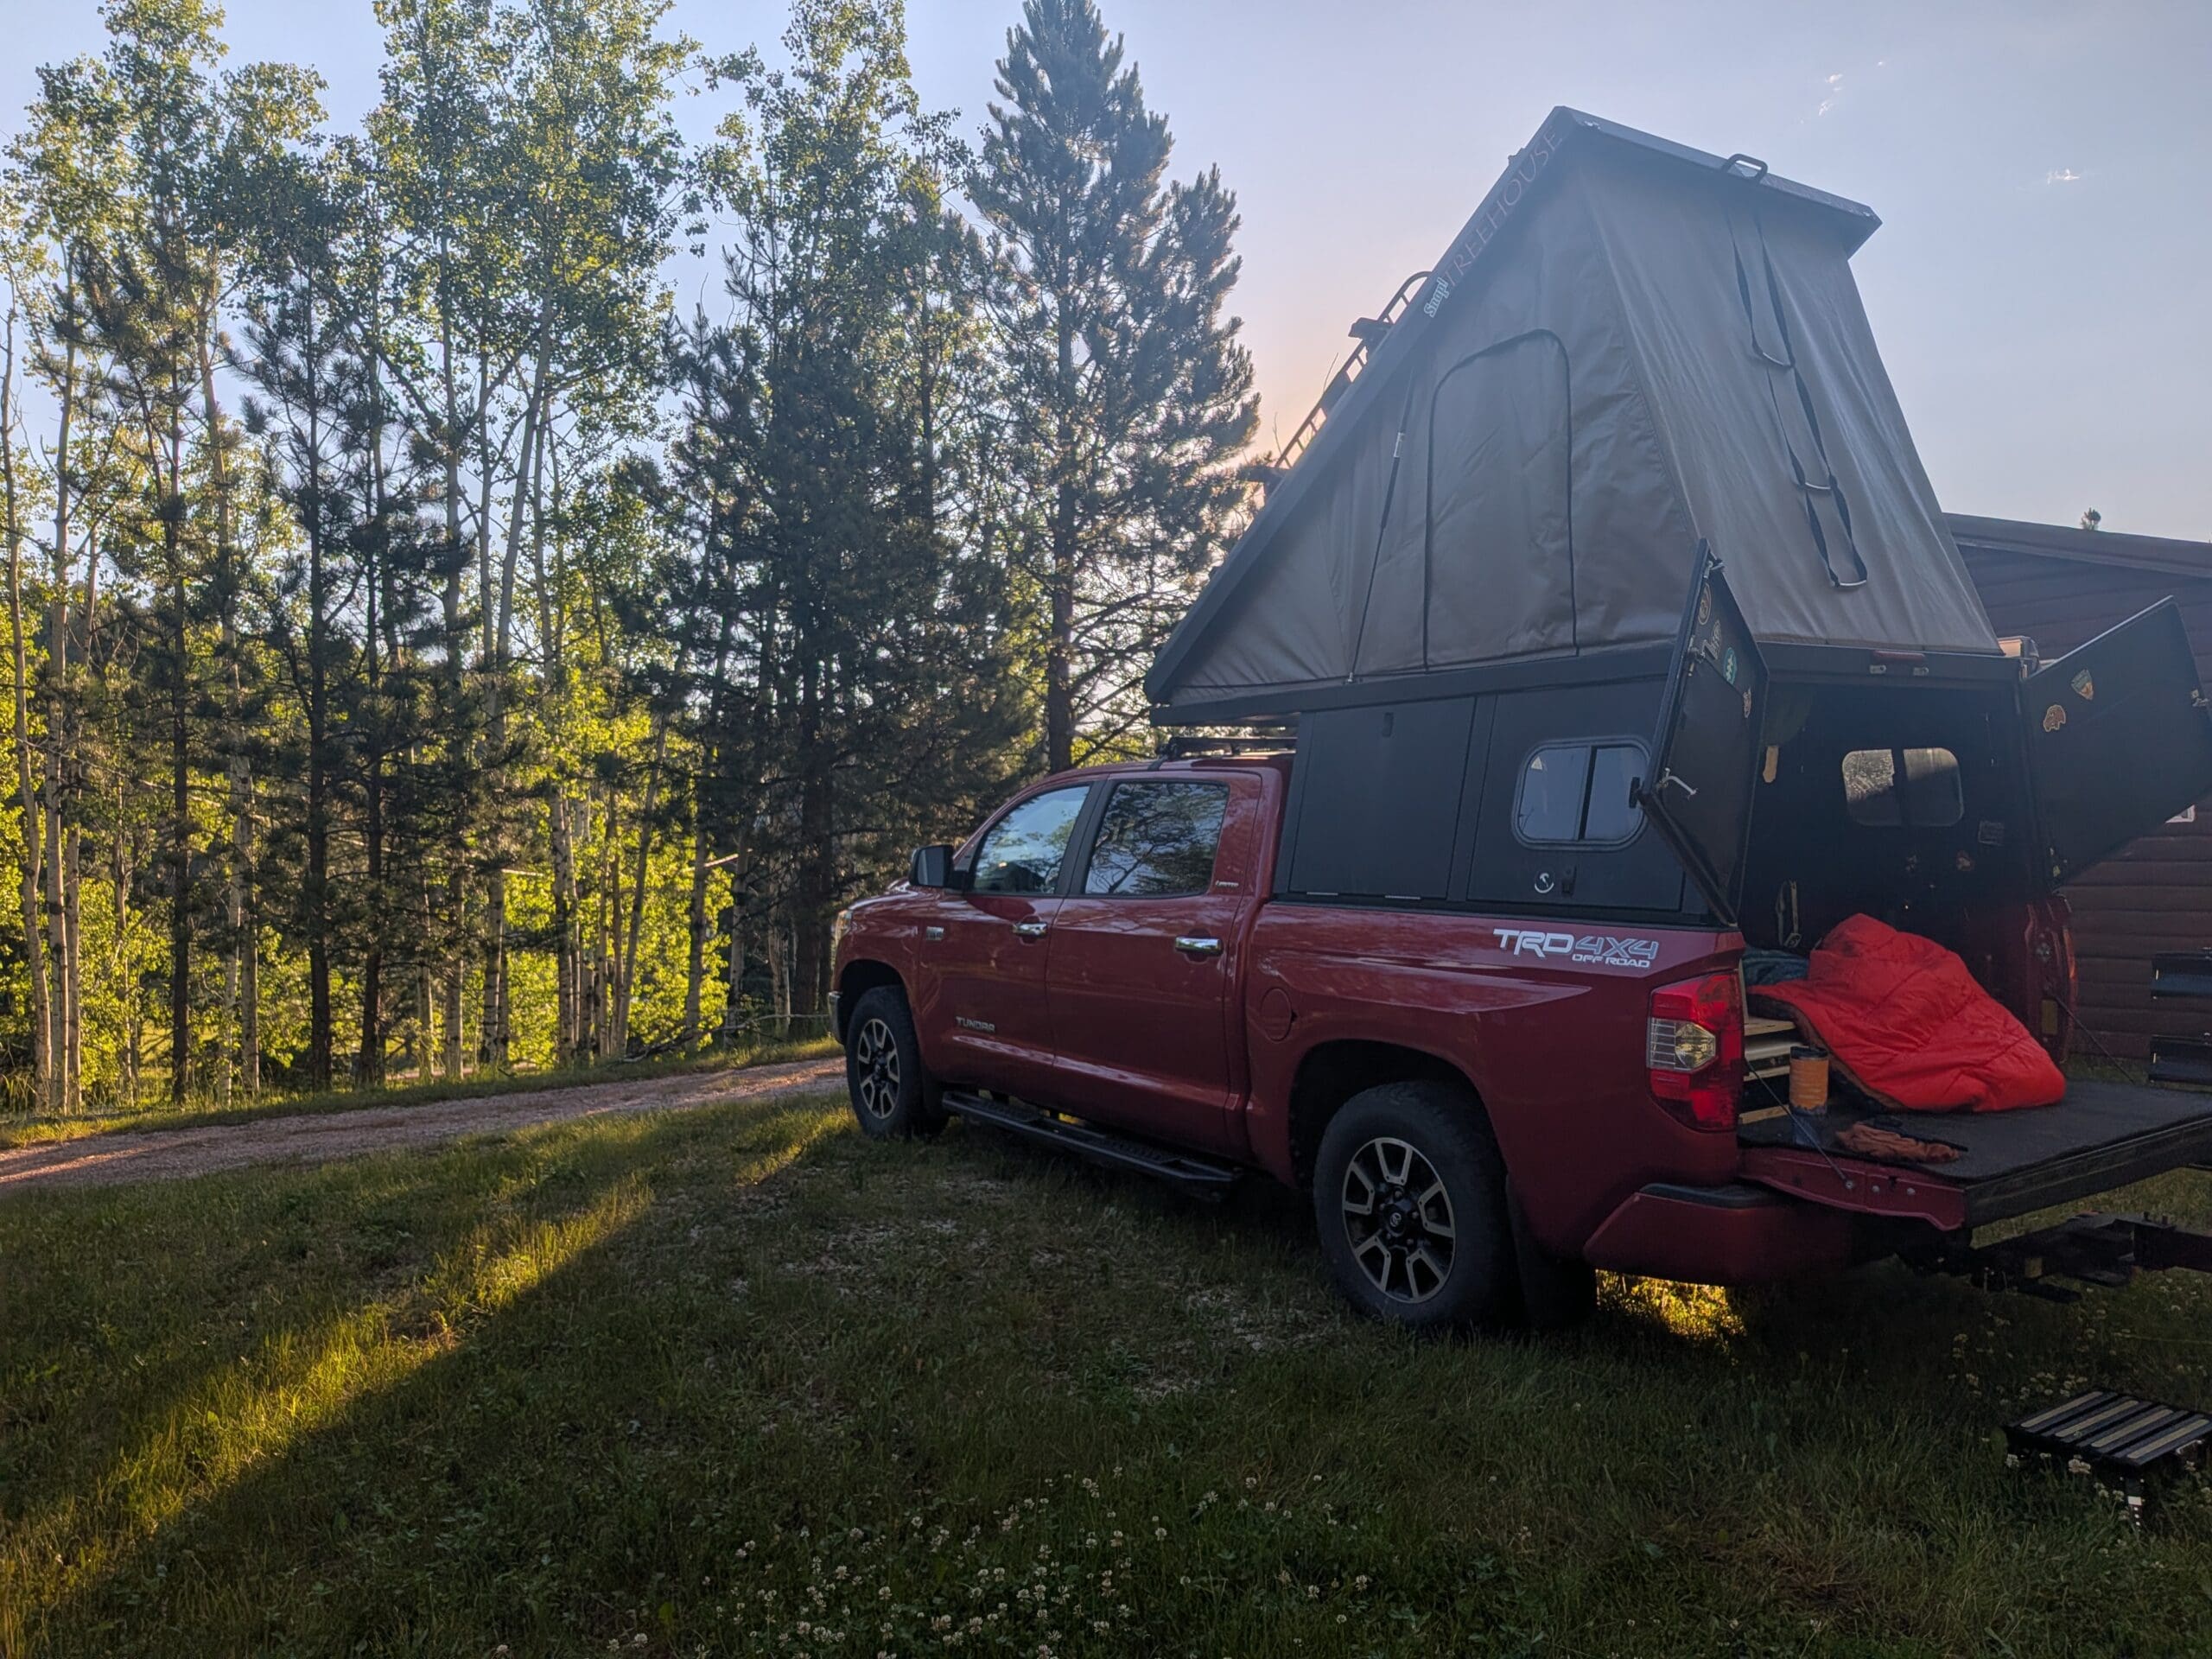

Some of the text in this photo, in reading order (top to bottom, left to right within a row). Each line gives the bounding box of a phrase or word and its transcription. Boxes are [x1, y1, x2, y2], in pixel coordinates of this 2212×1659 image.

[1423, 276, 1450, 318] Snap!
[1493, 928, 1574, 958] TRD
[1572, 953, 1650, 968] OFF ROAD
[956, 1016, 995, 1033] TUNDRA
